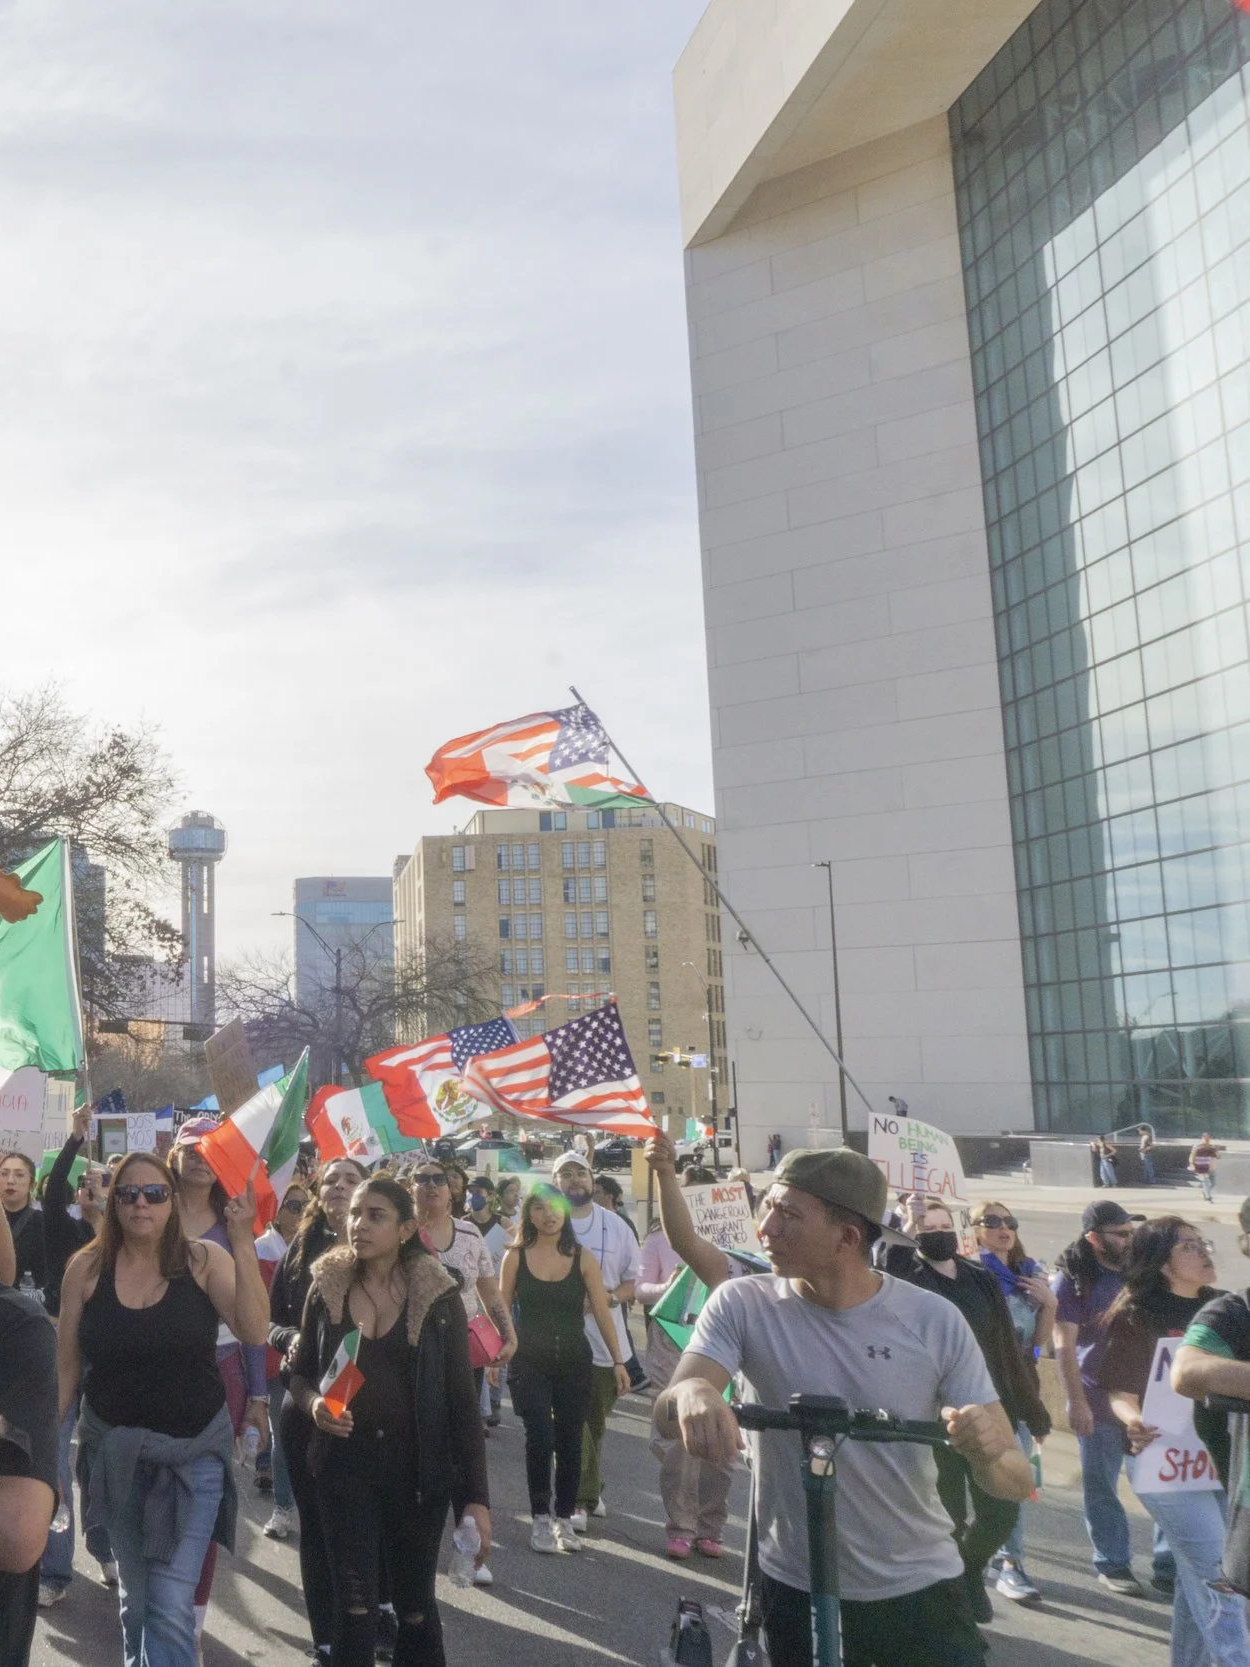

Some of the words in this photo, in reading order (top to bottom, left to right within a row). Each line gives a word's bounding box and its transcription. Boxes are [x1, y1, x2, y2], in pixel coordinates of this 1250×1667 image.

[874, 1117, 899, 1134] NO
[907, 1121, 949, 1145] HUMAN
[898, 1136, 938, 1154] BEING
[910, 1152, 928, 1164] IS
[686, 1191, 706, 1208] THE
[711, 1186, 744, 1204] MOST
[696, 1204, 750, 1224] DANGEROUS
